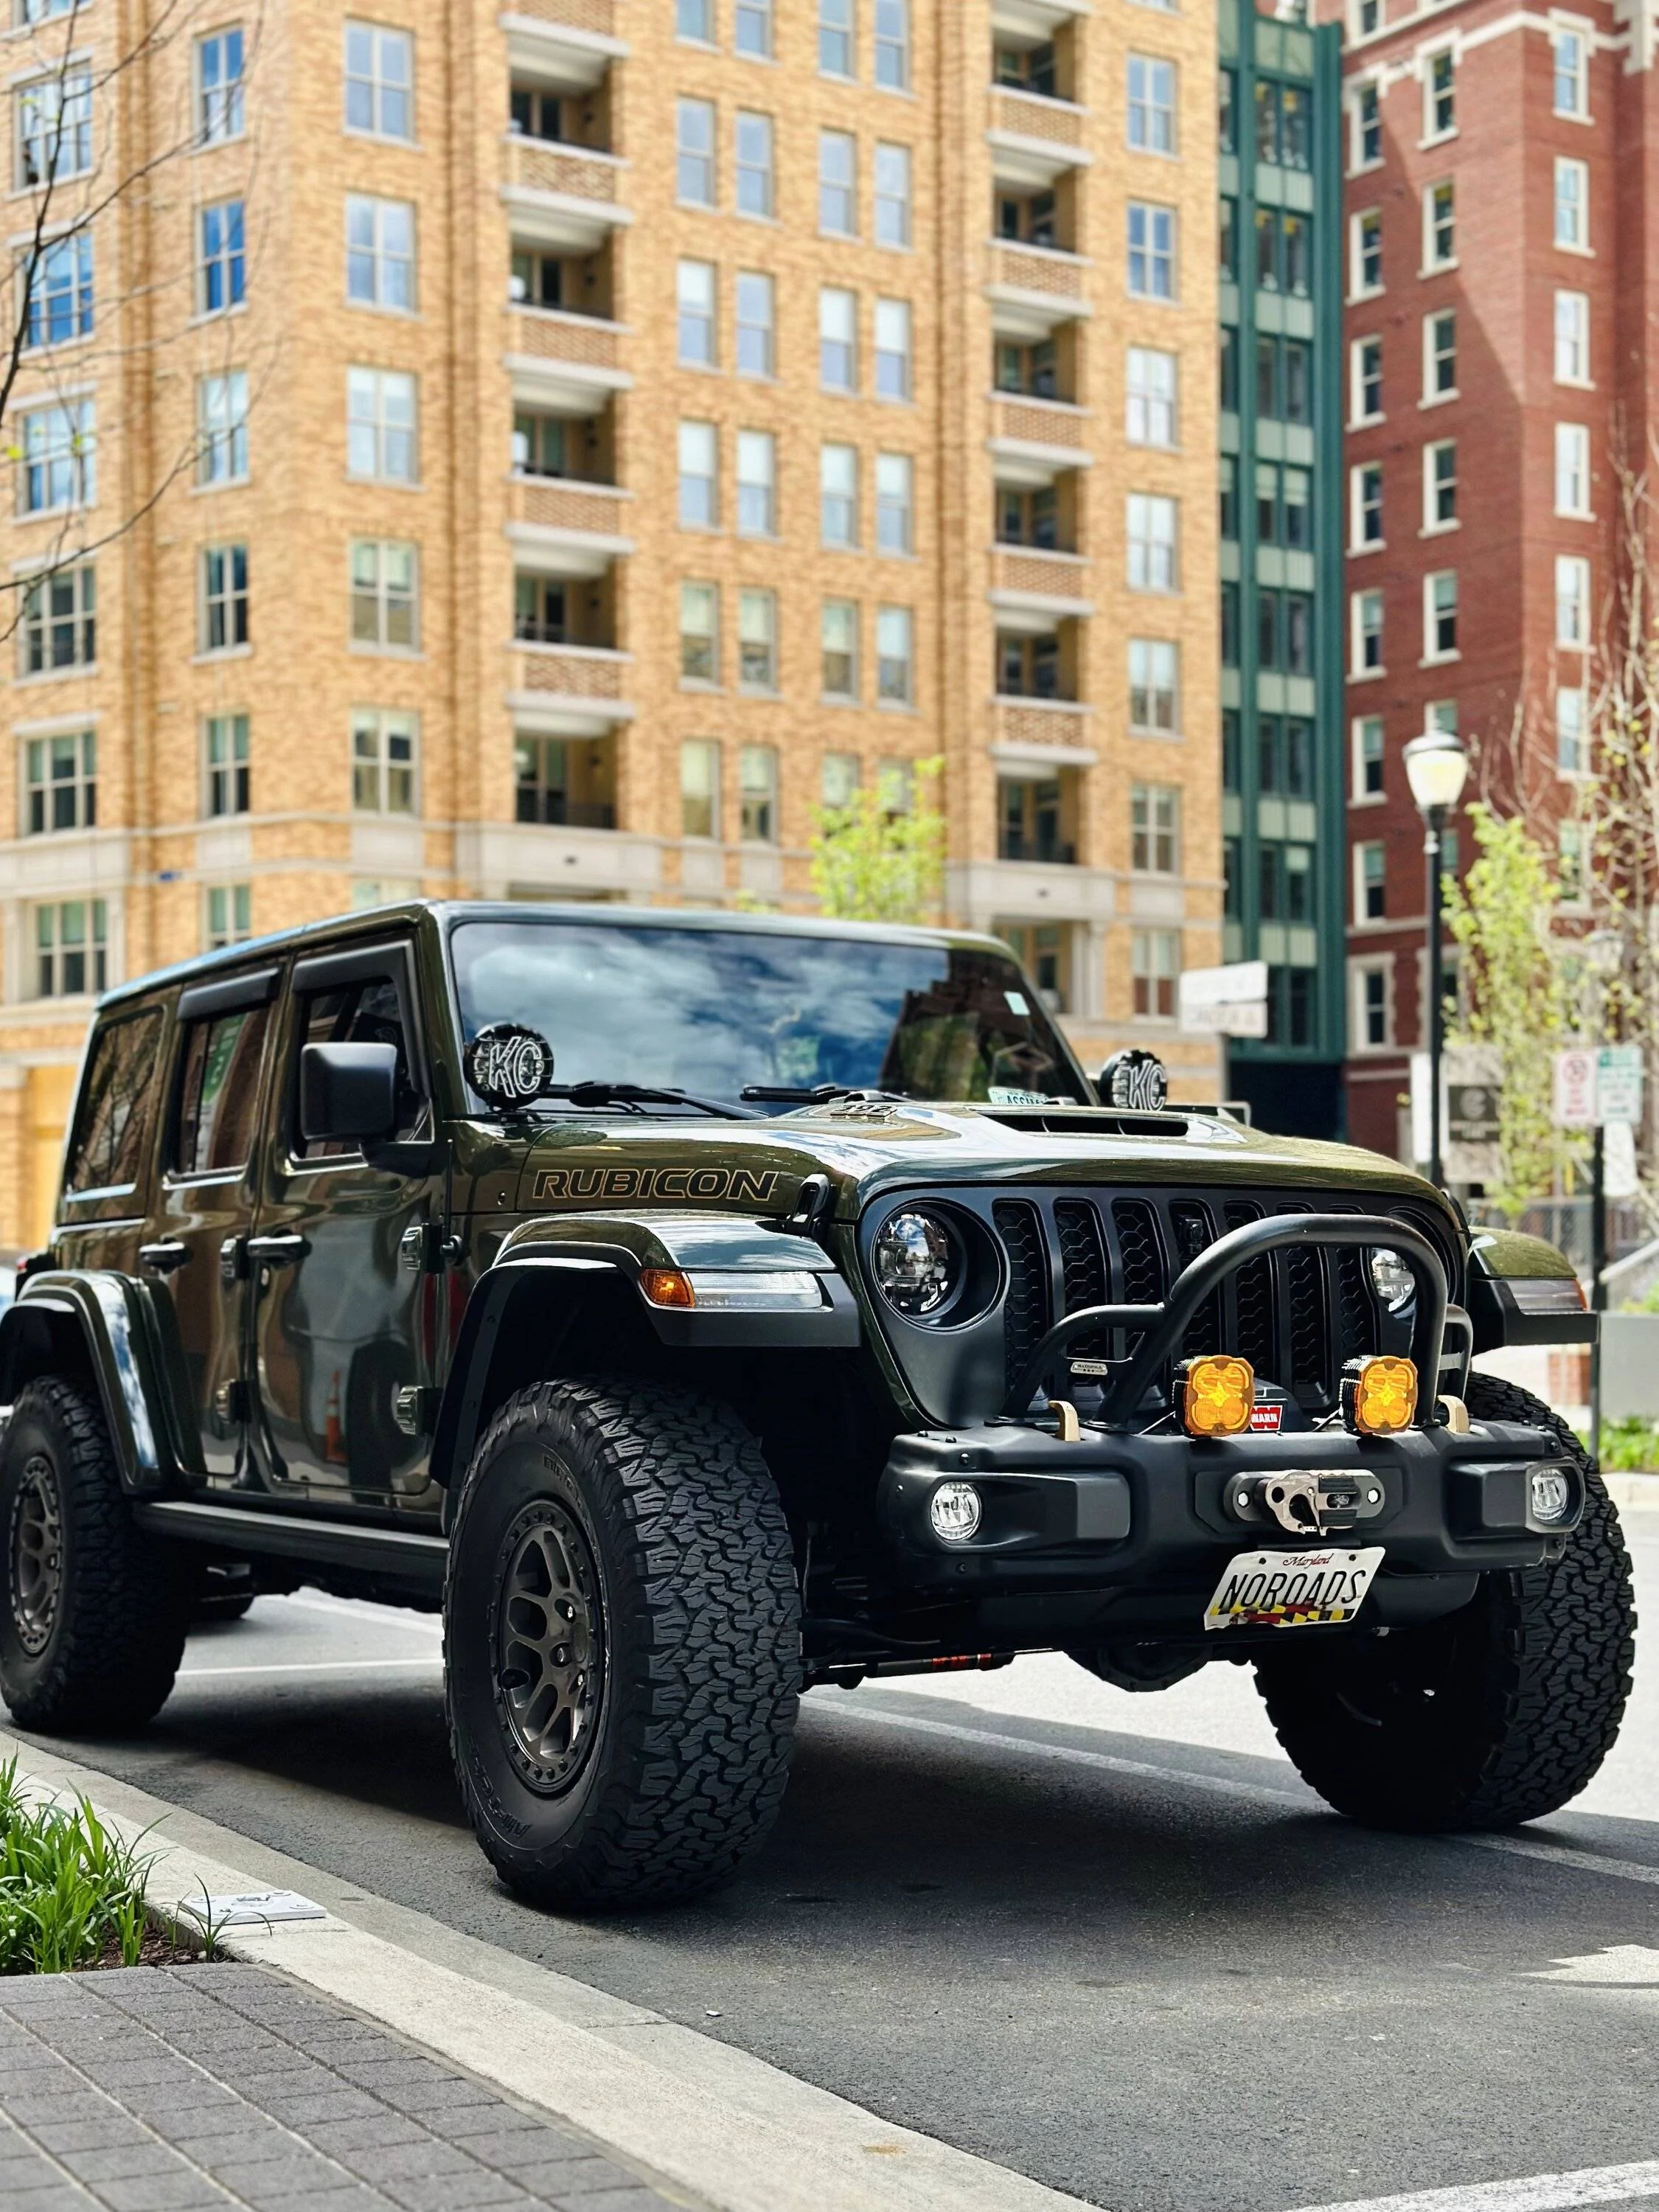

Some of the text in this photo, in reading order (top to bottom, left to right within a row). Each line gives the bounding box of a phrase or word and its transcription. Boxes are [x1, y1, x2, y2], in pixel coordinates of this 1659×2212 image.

[489, 1036, 542, 1098] KC
[1129, 1060, 1166, 1111] KC
[532, 1169, 779, 1202] RUBICON
[1282, 1554, 1335, 1569] Maryland
[1219, 1570, 1366, 1610] NOROADS
